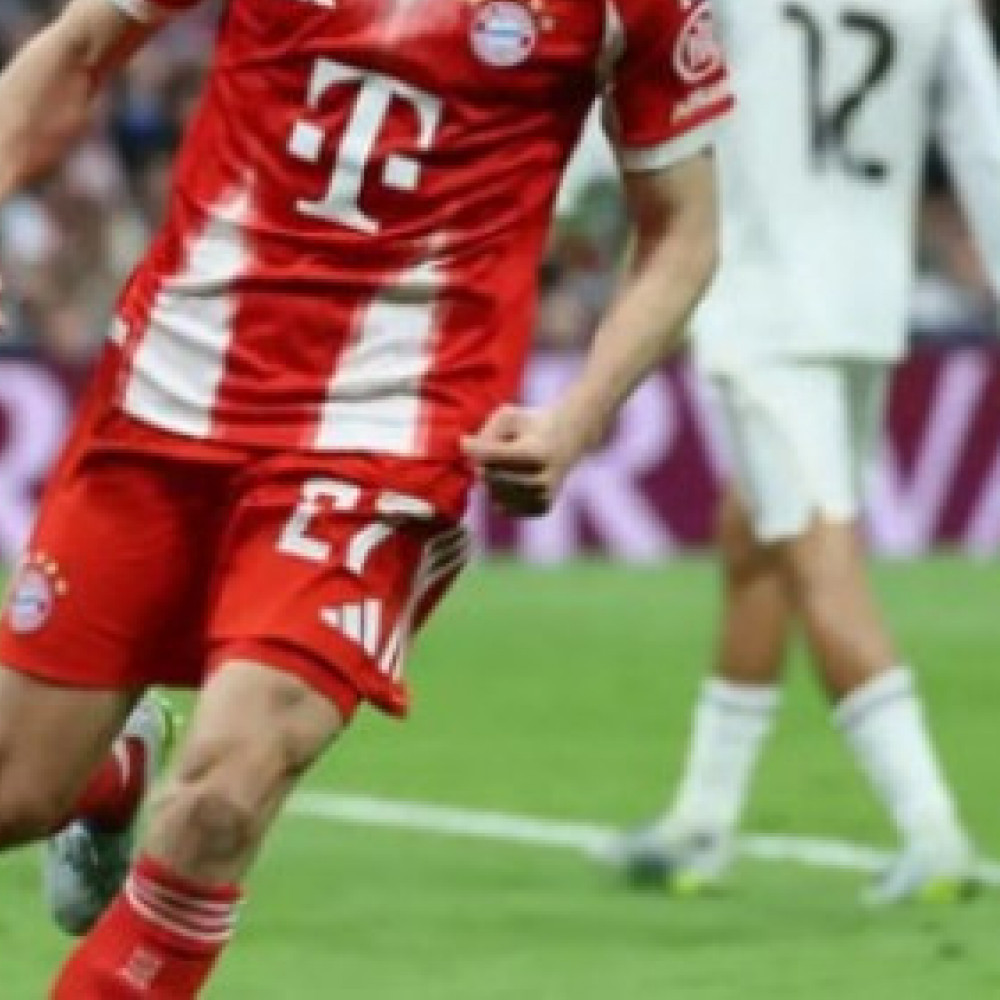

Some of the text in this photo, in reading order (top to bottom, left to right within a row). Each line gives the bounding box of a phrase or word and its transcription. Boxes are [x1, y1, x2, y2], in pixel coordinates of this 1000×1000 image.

[287, 57, 444, 236] T
[782, 0, 897, 182] 12
[276, 478, 435, 576] 27
